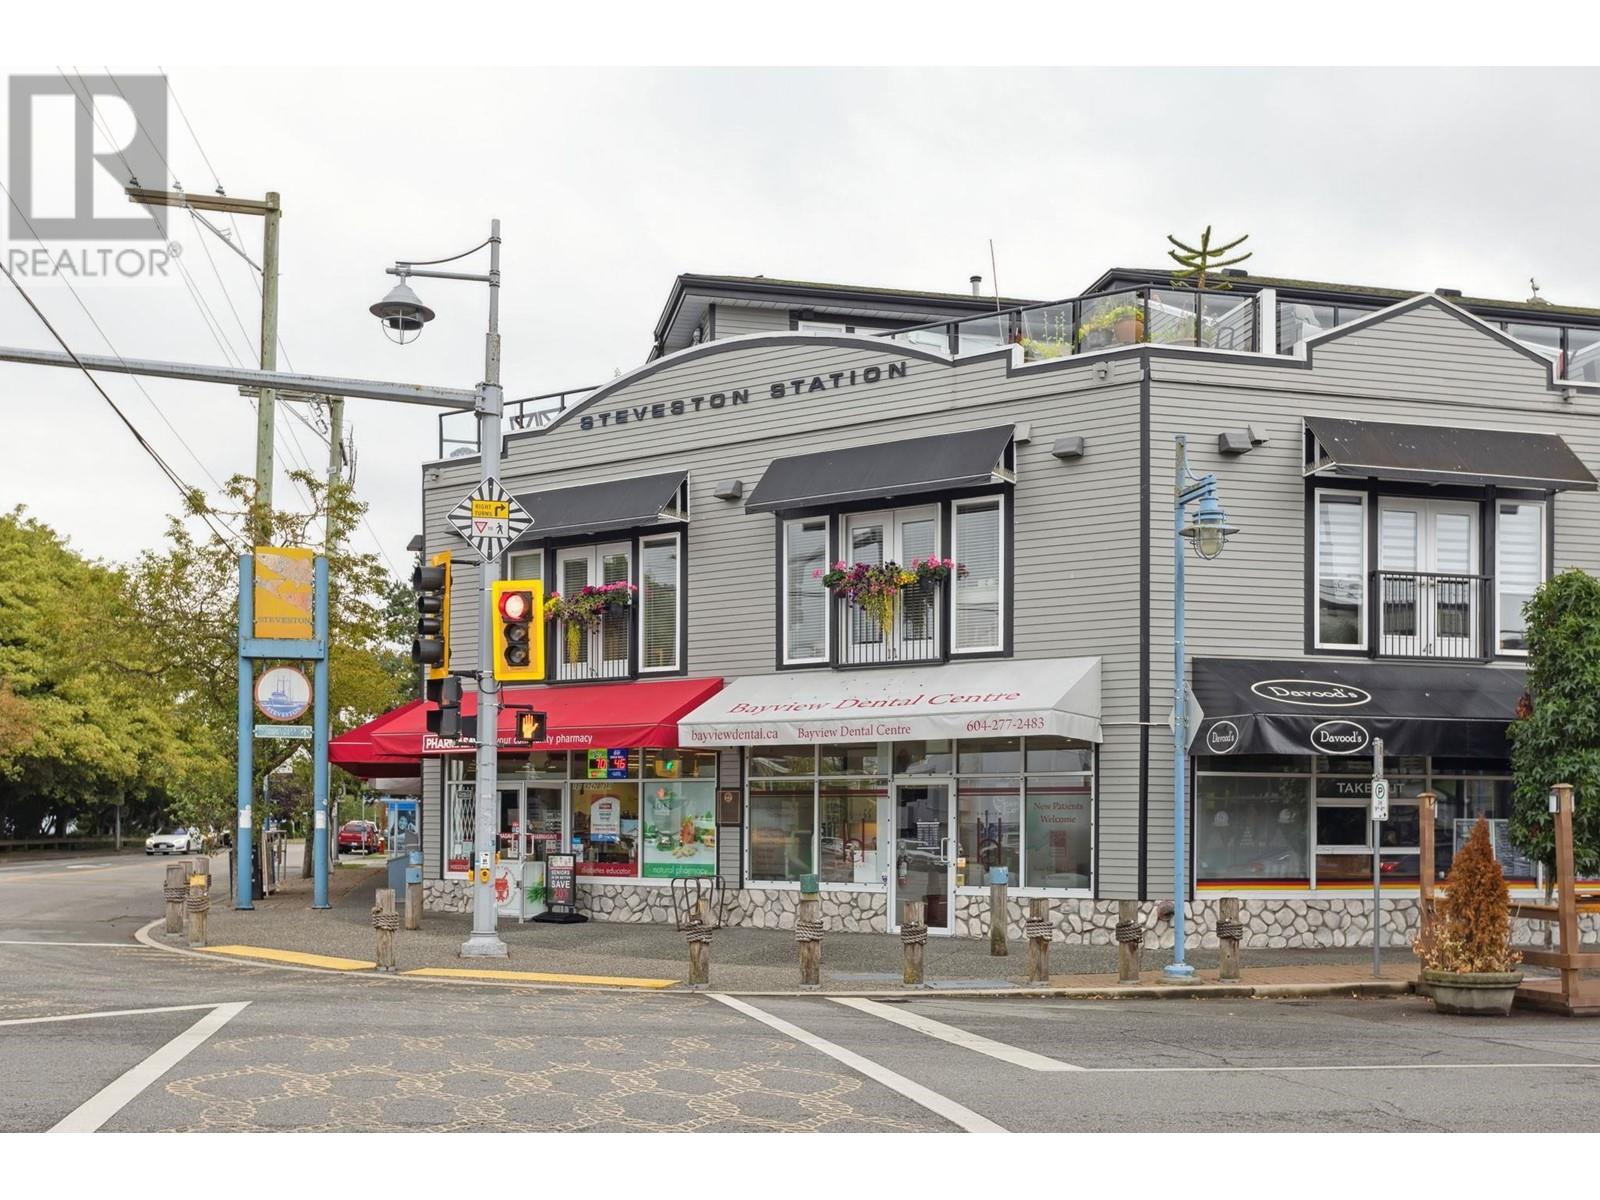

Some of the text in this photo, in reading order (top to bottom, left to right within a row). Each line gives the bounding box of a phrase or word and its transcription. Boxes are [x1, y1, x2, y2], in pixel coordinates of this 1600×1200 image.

[580, 361, 907, 430] STEVESTON STATION
[258, 616, 311, 624] STEVESTON
[1268, 686, 1358, 699] Davood's
[727, 691, 1022, 715] Bayview Dental Centre
[267, 706, 303, 718] STEVESTON
[691, 717, 1045, 742] bayviewdental.ca Bayview Dental Centre 604-277-2483
[555, 734, 593, 745] pharmacy
[1212, 730, 1234, 743] Davood's
[1320, 730, 1362, 743] Davood's
[614, 759, 626, 769] 46
[1336, 782, 1405, 794] TAKE UT
[1034, 802, 1084, 810] New Patients
[1040, 815, 1077, 823] Welcome
[581, 866, 605, 874] diabetes
[653, 866, 707, 876] natural pharmacy
[551, 880, 571, 889] SAVE
